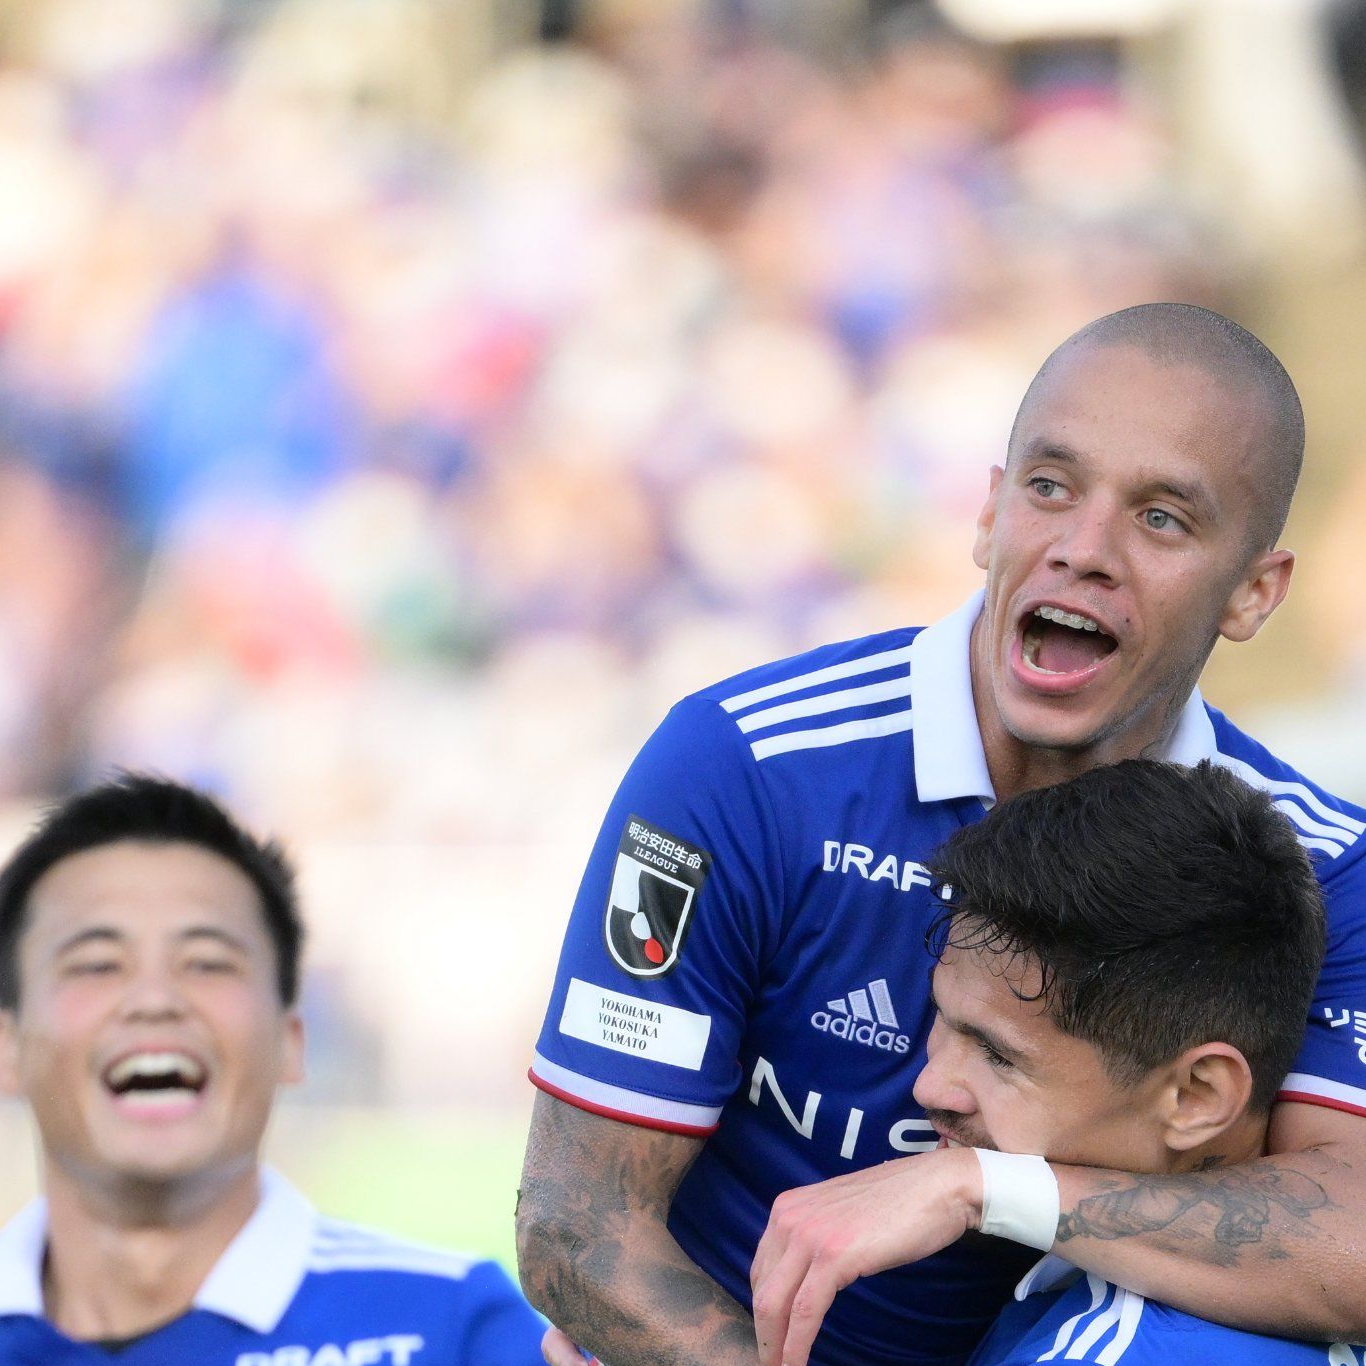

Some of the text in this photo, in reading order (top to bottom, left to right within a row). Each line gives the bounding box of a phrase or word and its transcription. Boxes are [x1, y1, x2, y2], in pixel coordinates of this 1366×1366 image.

[628, 821, 703, 870] 明治安田生命
[600, 997, 662, 1024] YOKOHAMA
[598, 1012, 658, 1039] YOKOSUKA
[810, 1008, 911, 1055] adidas
[602, 1029, 647, 1051] YAMATO
